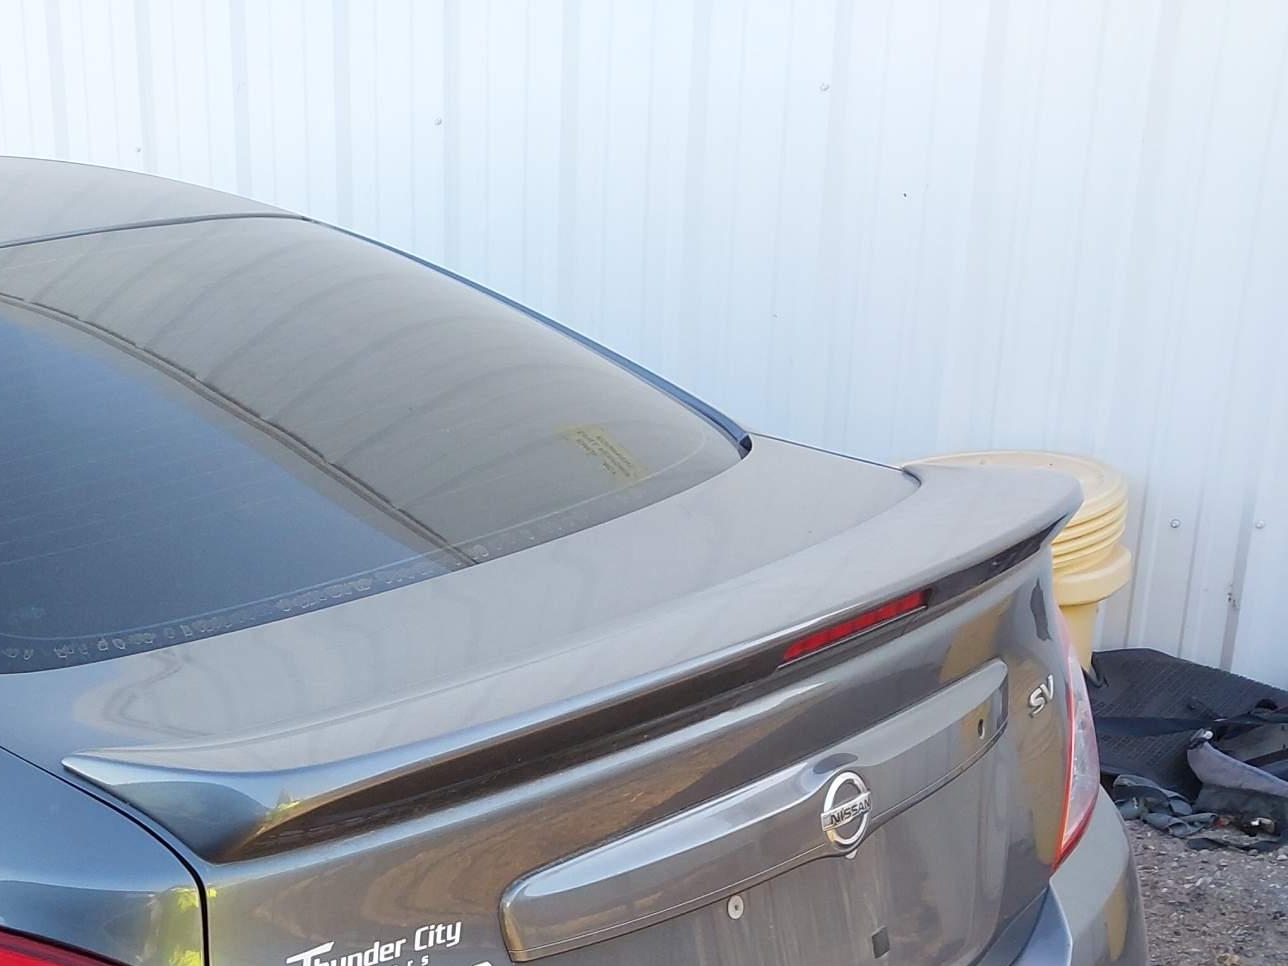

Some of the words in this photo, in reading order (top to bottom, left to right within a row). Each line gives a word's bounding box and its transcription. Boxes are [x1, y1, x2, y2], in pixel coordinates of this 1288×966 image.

[1030, 674, 1054, 714] SV
[830, 797, 872, 826] NISSAN
[414, 921, 463, 952] City
